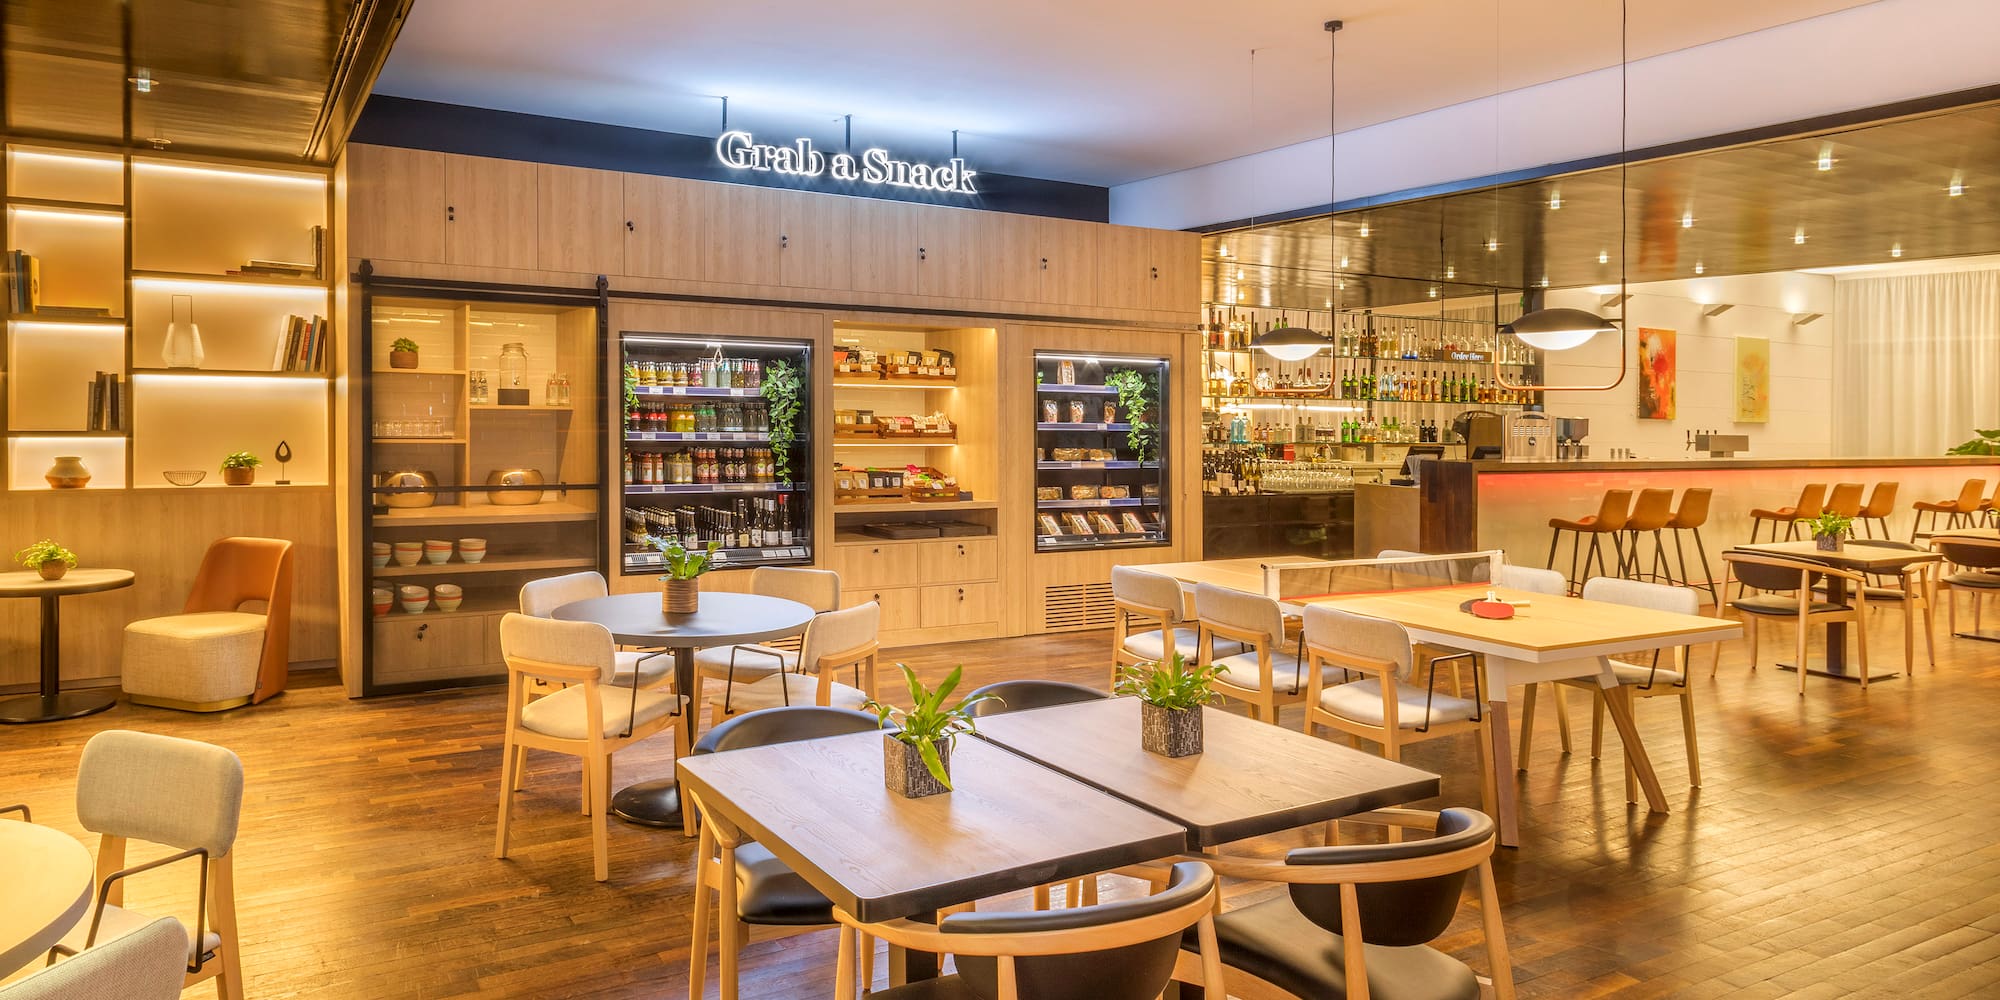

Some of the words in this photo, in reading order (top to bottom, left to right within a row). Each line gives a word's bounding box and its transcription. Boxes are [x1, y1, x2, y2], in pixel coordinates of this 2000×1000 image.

[717, 131, 824, 176] Grab
[832, 153, 859, 180] a
[863, 149, 977, 194] Snack
[1451, 352, 1468, 360] Order
